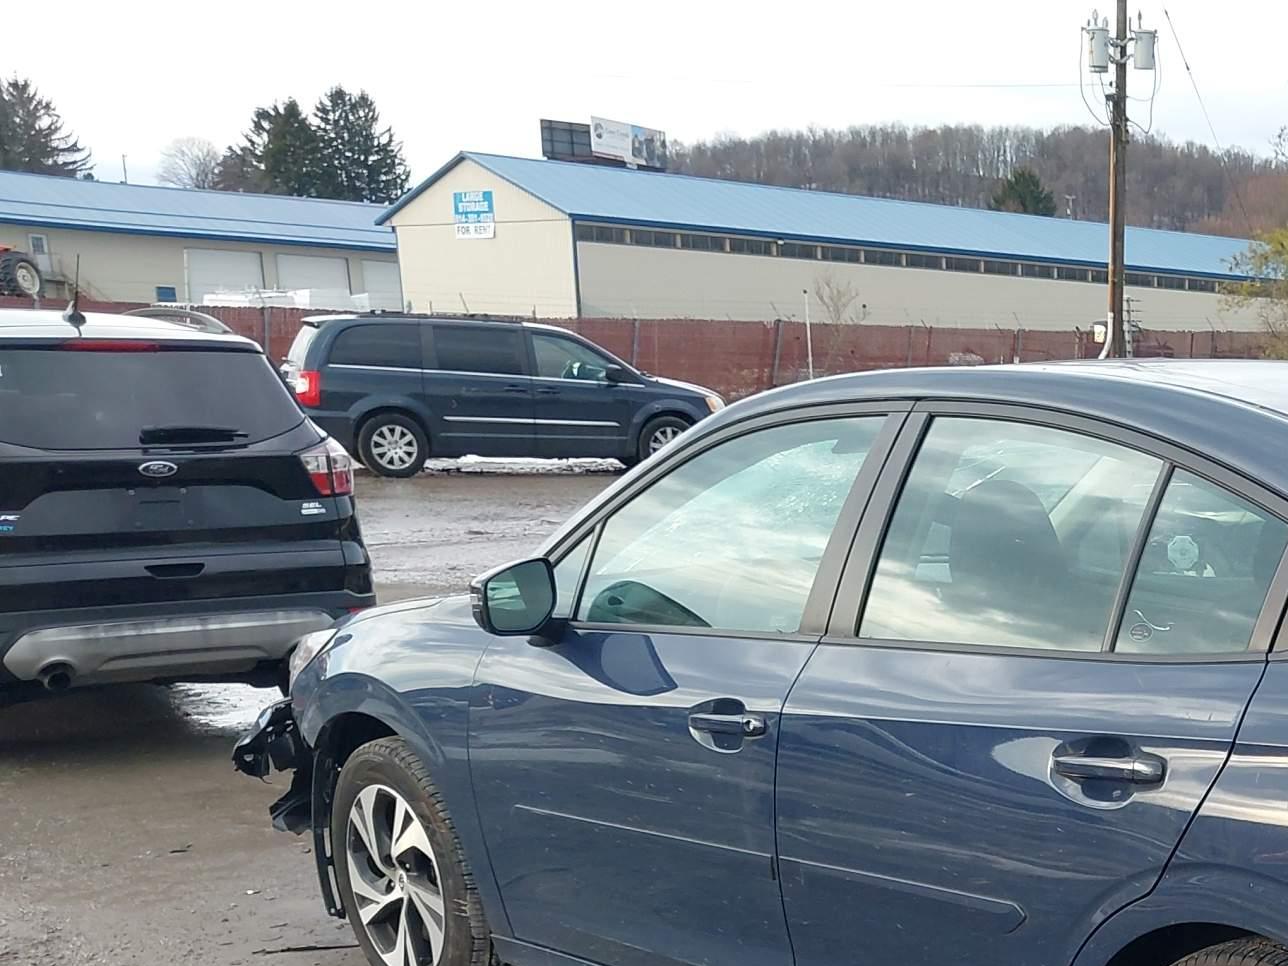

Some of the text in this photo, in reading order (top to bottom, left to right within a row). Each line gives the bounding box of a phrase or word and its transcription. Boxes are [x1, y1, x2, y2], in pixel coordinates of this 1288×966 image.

[458, 201, 489, 212] STORAGE
[457, 224, 491, 235] FOR RENT
